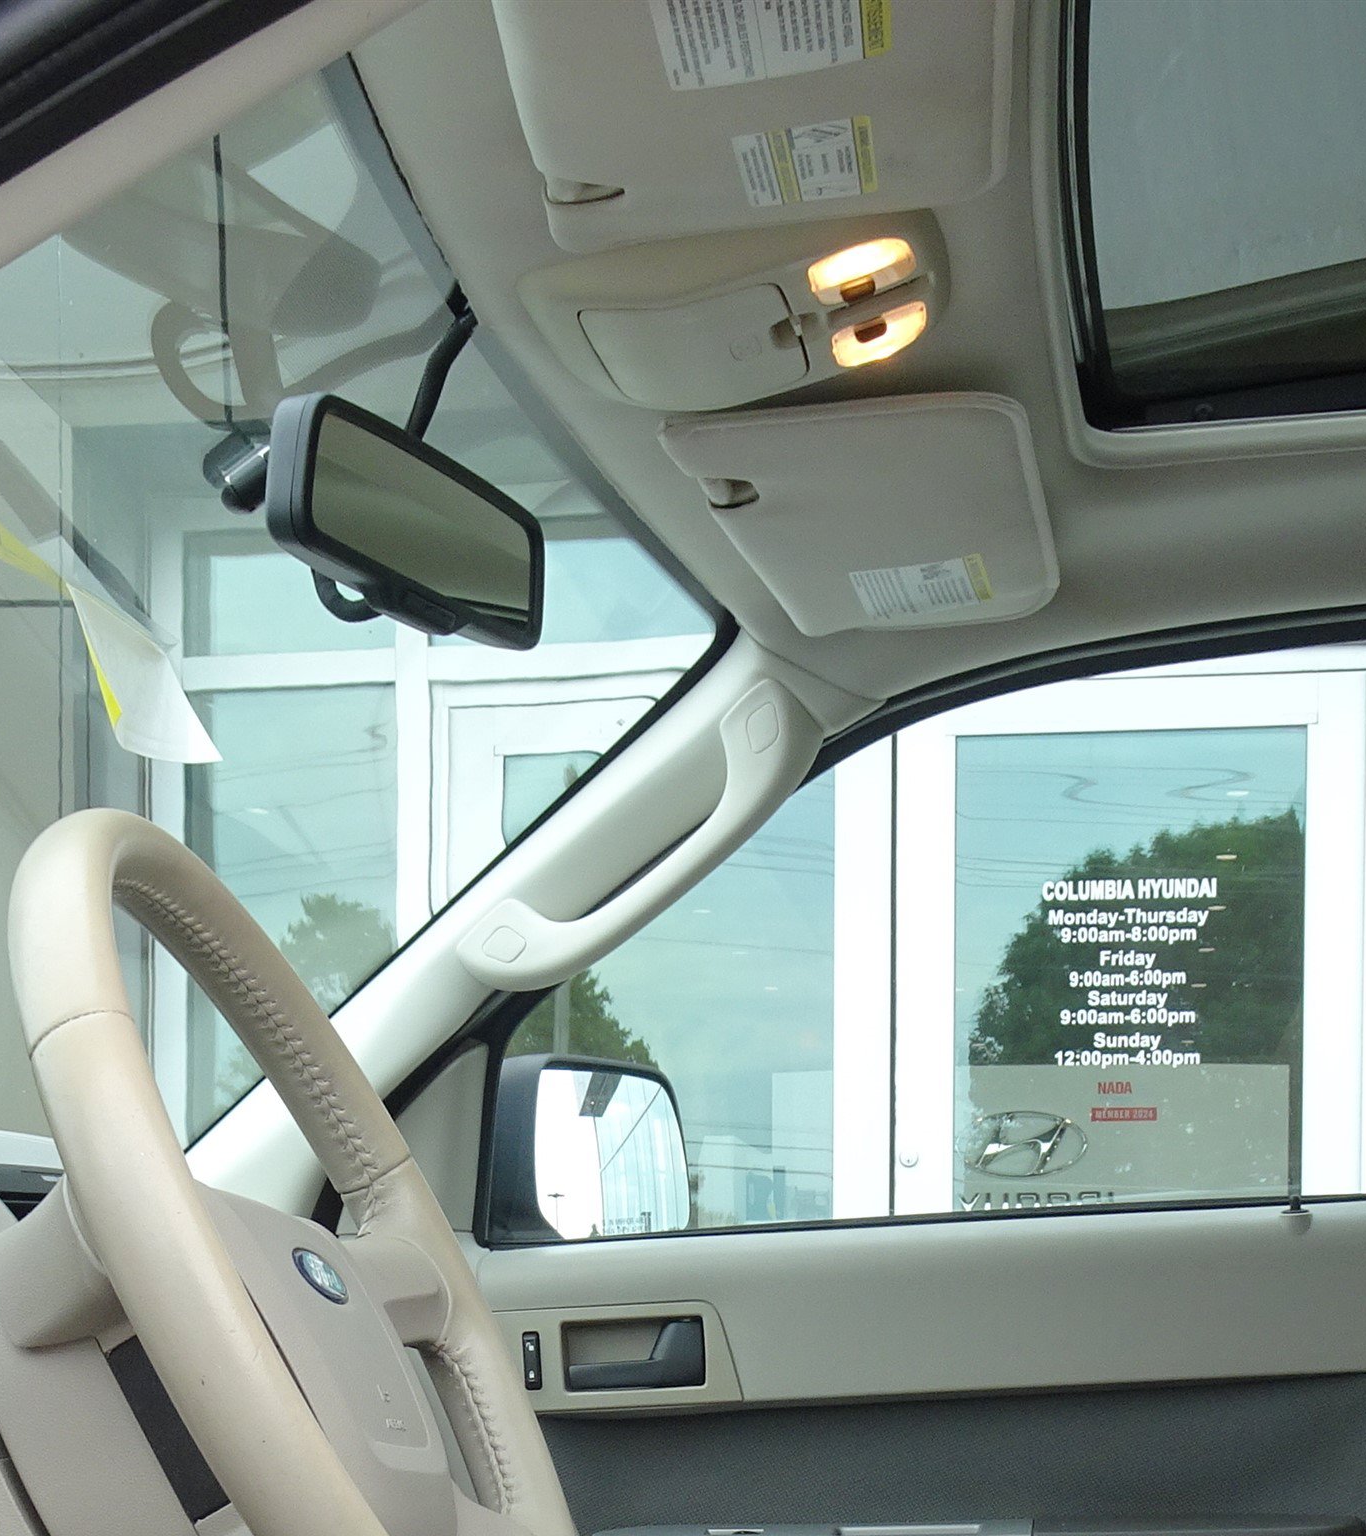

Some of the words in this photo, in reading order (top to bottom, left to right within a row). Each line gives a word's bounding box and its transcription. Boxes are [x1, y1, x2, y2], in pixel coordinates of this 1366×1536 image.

[1042, 880, 1135, 901] COLUMBIA
[1138, 877, 1218, 898] HYUNDAI
[1048, 907, 1209, 926] Monday-Thursday
[1060, 926, 1197, 944] 9:00am-8:00pm
[1099, 950, 1156, 968] Friday
[1069, 970, 1187, 988] 9:00am-6:00pm
[1087, 990, 1168, 1008] Saturday
[1060, 1008, 1196, 1026] 9:00am-6:00pm
[1093, 1032, 1161, 1050] Sunday
[1055, 1050, 1201, 1068] 12:00pm-4:00pm
[1097, 1081, 1133, 1094] NADA
[1095, 1109, 1130, 1119] MEMBER
[1133, 1109, 1155, 1119] 2024
